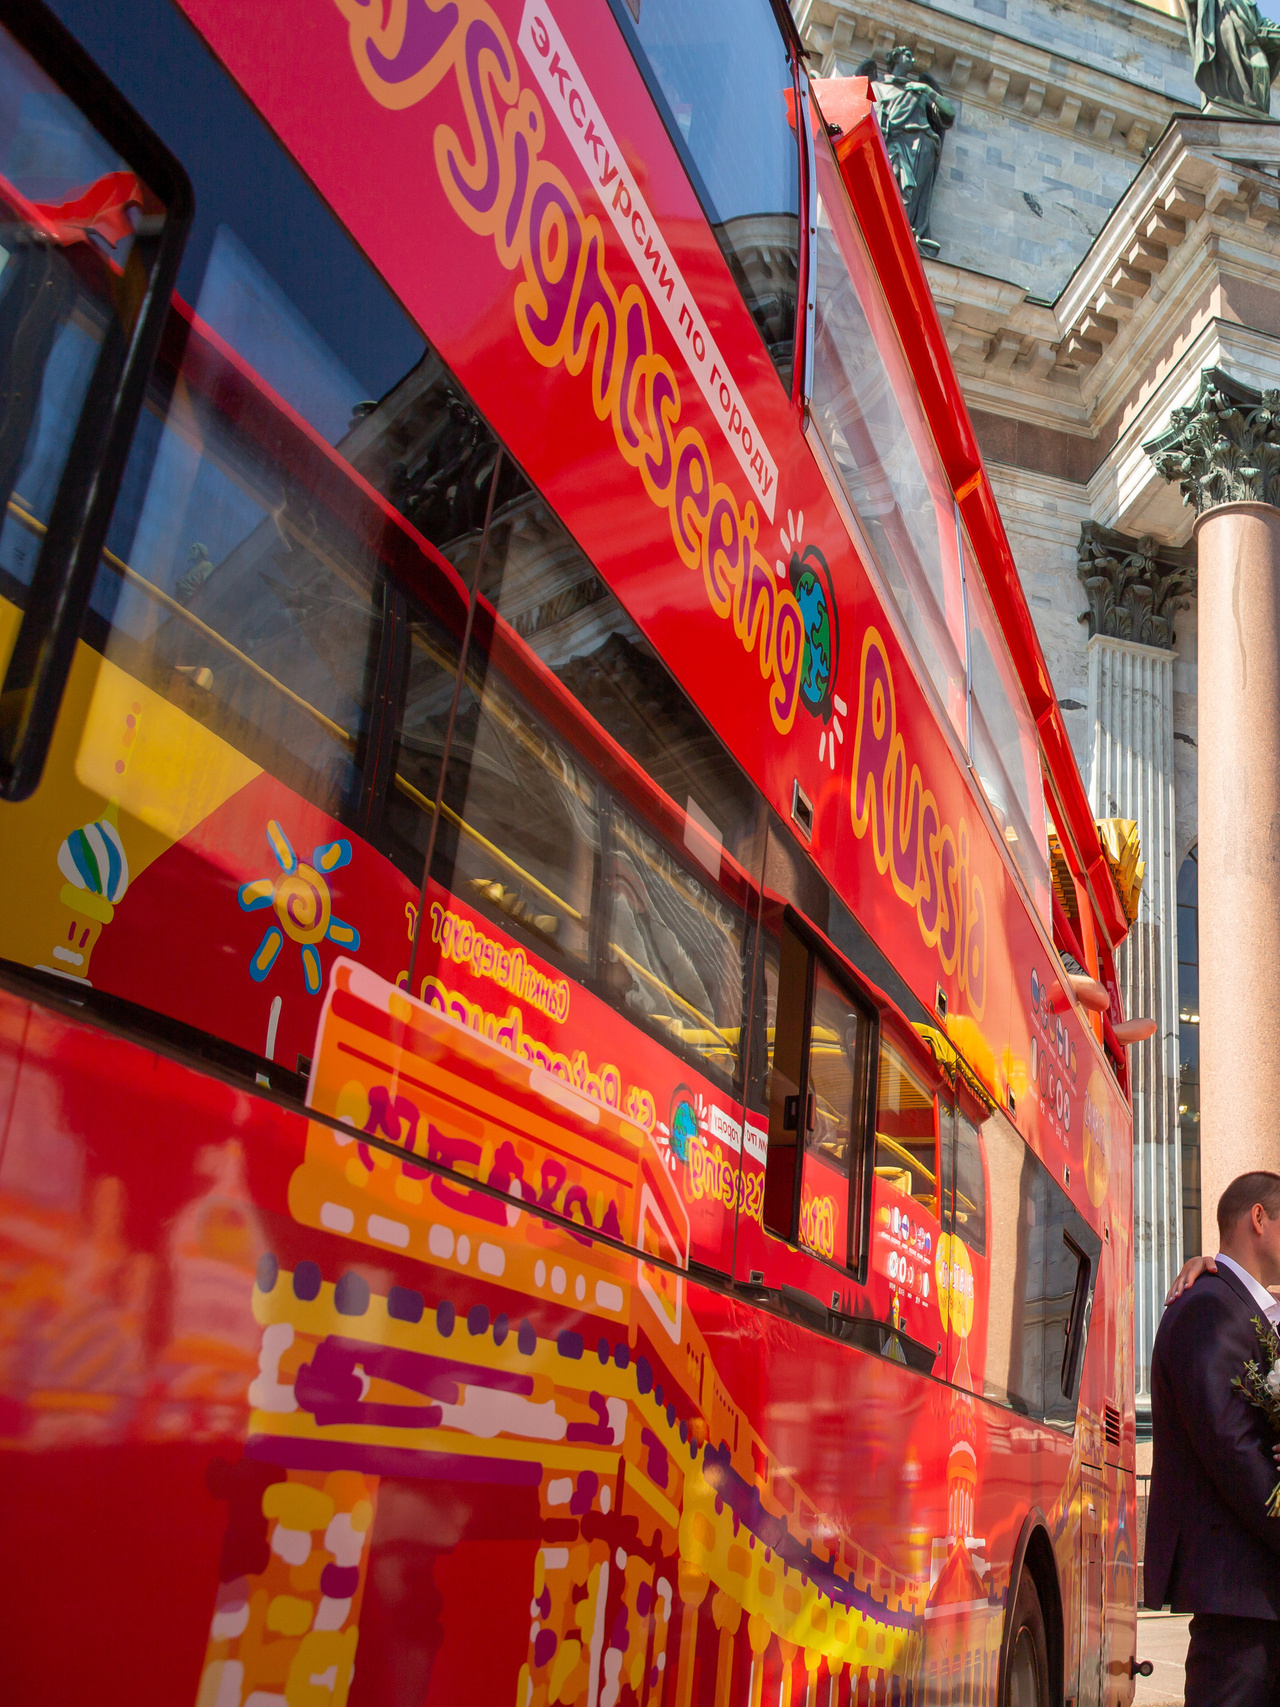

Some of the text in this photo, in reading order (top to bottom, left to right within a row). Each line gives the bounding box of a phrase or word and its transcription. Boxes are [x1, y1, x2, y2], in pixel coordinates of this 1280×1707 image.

[678, 302, 706, 362] по
[709, 363, 774, 496] городу
[851, 626, 988, 1022] Russia
